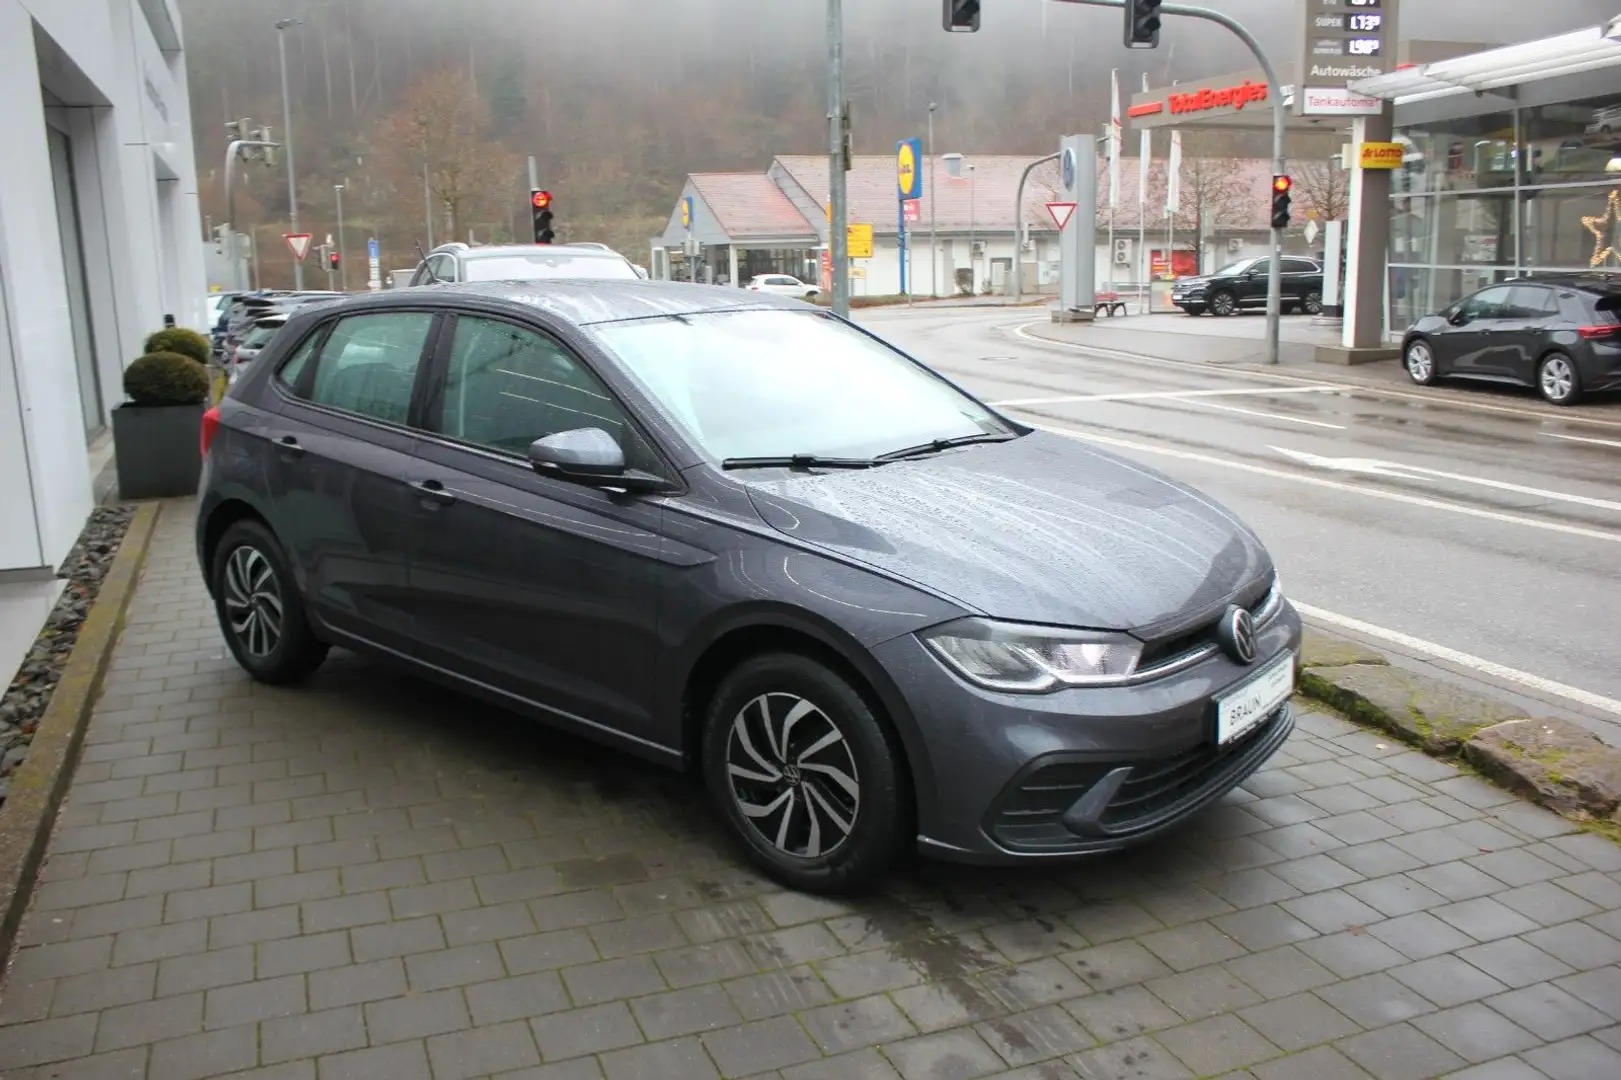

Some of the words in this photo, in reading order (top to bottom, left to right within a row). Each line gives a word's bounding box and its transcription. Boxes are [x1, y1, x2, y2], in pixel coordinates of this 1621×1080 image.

[1310, 64, 1382, 77] Autowäsche
[1168, 80, 1268, 115] TotalEnergies
[1230, 694, 1262, 726] BRAUN
